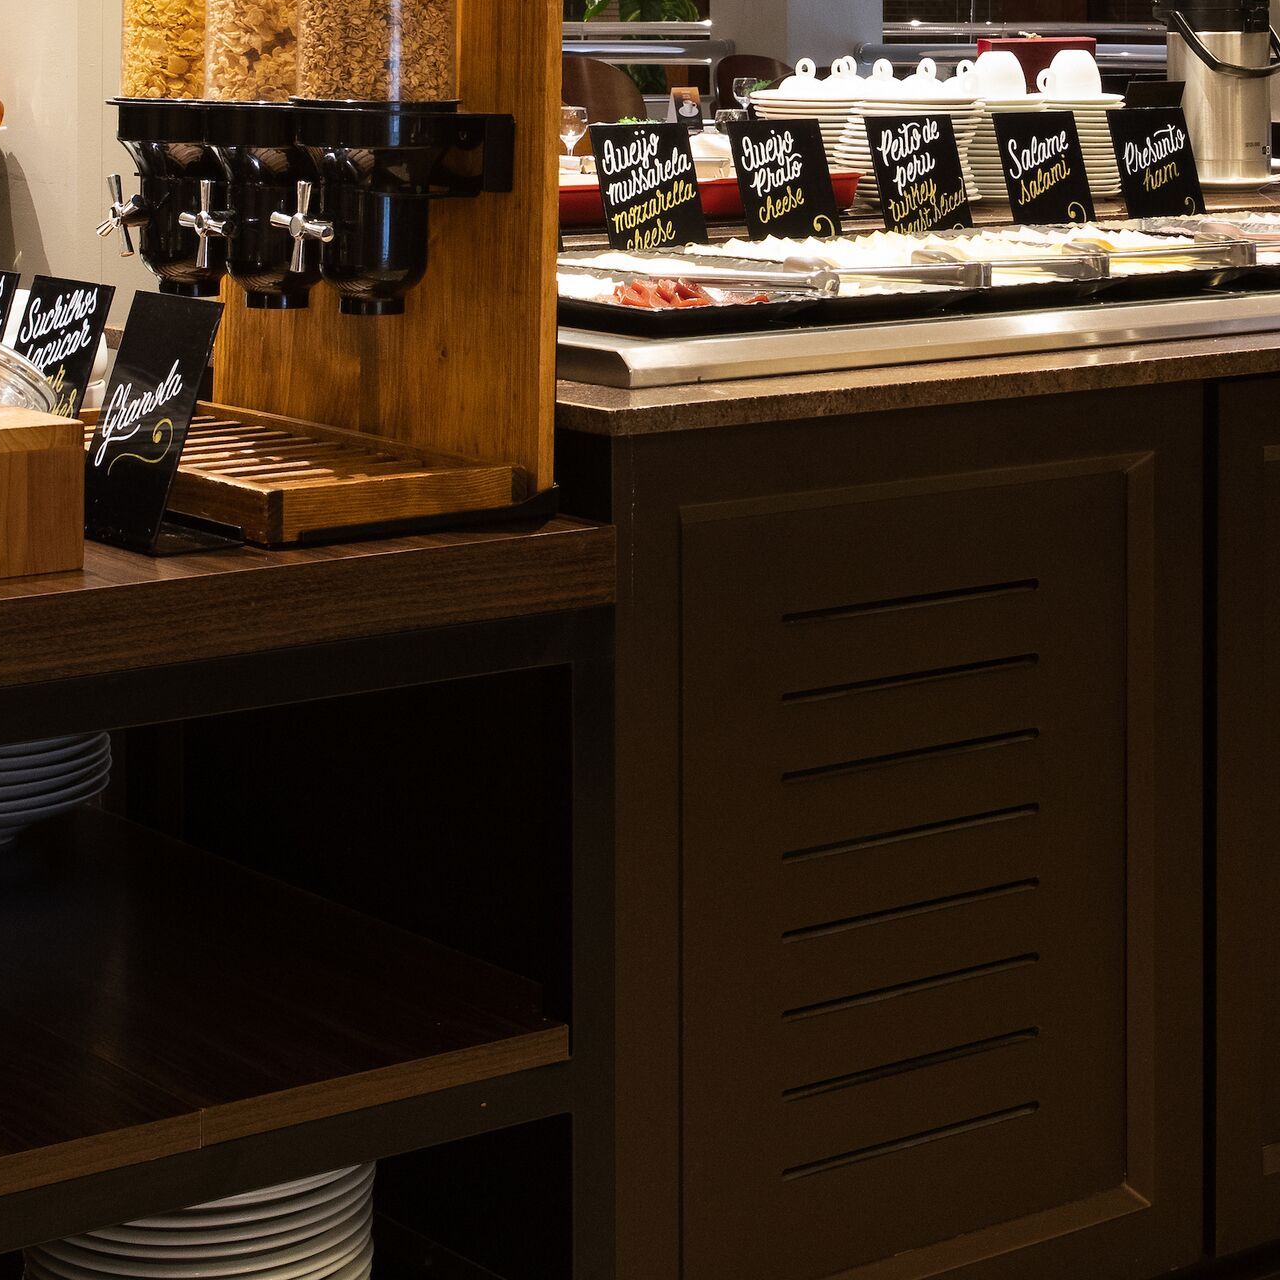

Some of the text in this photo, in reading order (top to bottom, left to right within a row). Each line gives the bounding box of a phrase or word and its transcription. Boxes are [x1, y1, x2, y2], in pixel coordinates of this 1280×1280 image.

[602, 129, 660, 175] Queijo
[742, 129, 794, 172] Queijo
[877, 118, 939, 166] Peito de
[1008, 130, 1069, 179] Salame
[1122, 124, 1186, 175] Presunto
[606, 147, 691, 205] mussarela
[893, 152, 936, 196] peru
[1018, 154, 1071, 205] salami
[1142, 162, 1180, 191] ham
[611, 180, 697, 233] mozzarella
[759, 186, 805, 223] cheese
[888, 178, 937, 221] turkey
[626, 218, 676, 249] cheese
[20, 287, 99, 343] Sucrilhos
[94, 359, 183, 467] Granola
